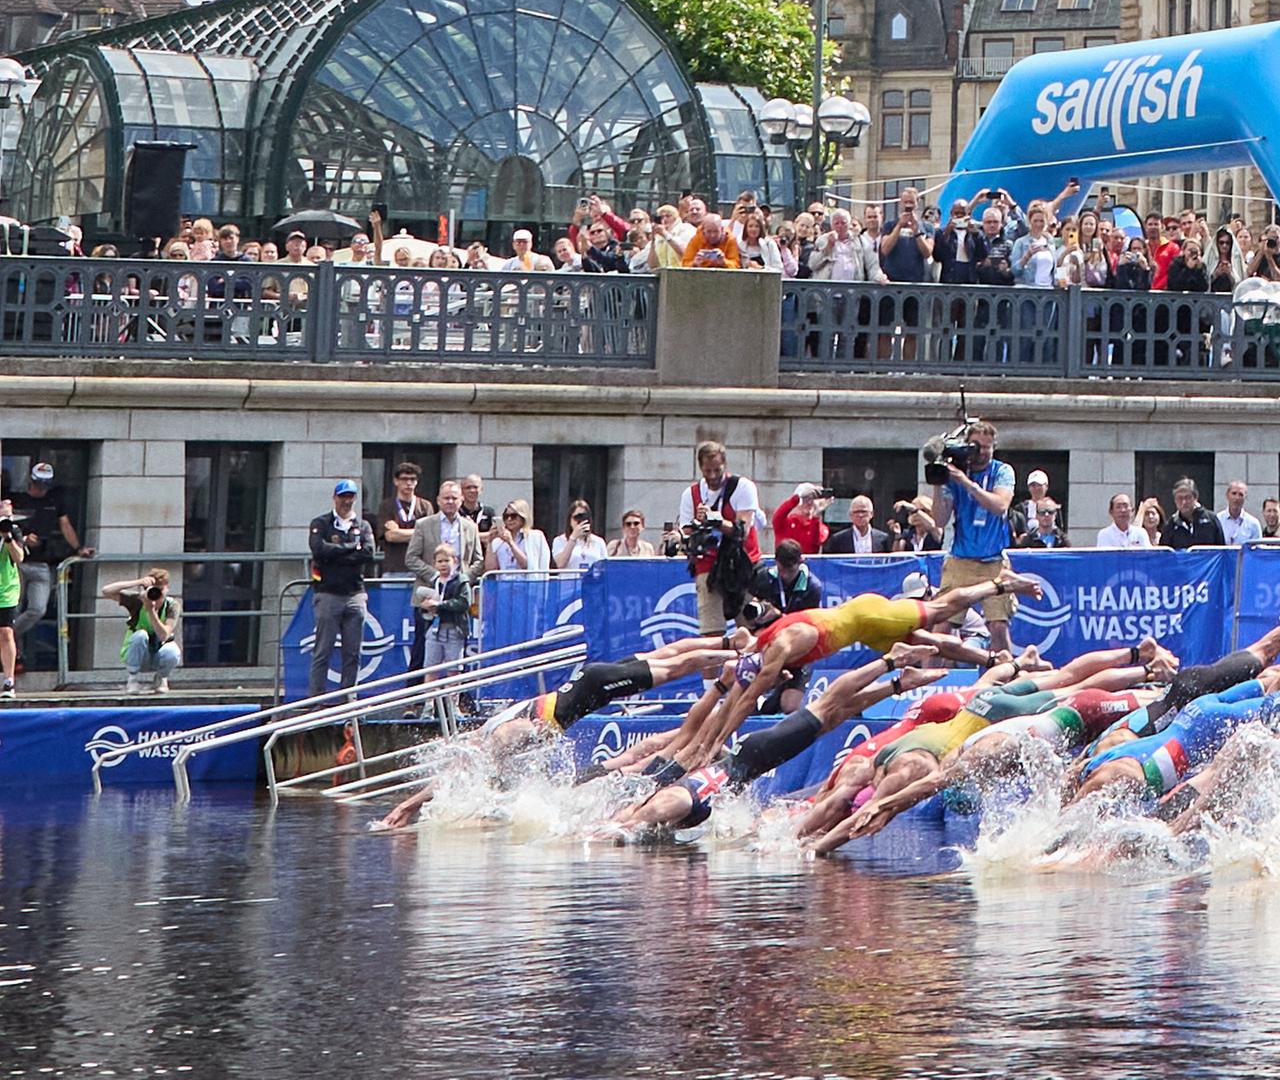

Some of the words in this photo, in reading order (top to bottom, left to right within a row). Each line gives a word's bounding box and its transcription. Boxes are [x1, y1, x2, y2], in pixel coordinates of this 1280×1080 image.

[1031, 49, 1204, 150] sailfish
[1078, 581, 1210, 610] HAMBURG
[1078, 612, 1184, 641] WASSER
